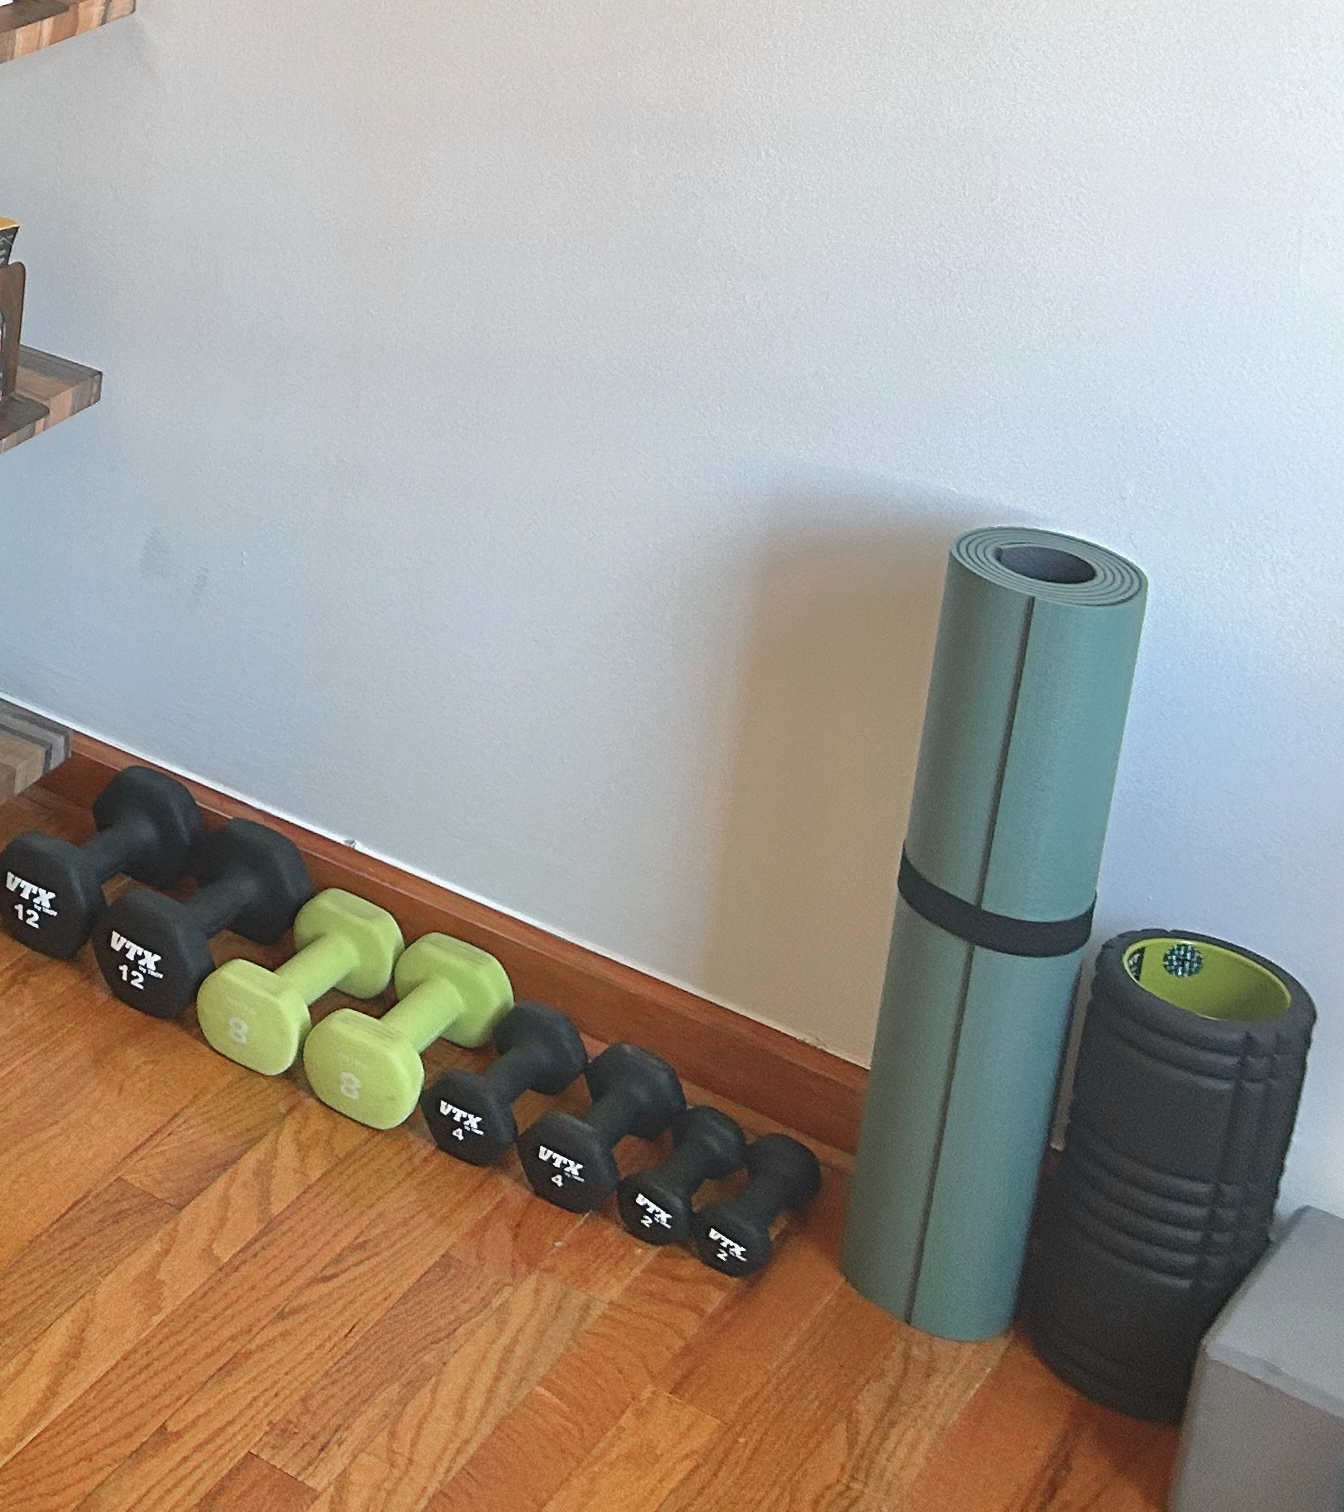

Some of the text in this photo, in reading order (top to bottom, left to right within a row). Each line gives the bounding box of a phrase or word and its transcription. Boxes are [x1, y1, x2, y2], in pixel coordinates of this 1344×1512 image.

[6, 871, 56, 908] VTX
[14, 903, 40, 929] 12
[110, 930, 161, 971] VTX
[119, 964, 144, 990] 12
[228, 1017, 248, 1044] 8
[340, 1072, 360, 1100] 8
[440, 1100, 482, 1129] VTX
[452, 1128, 464, 1140] 4
[538, 1145, 583, 1176] VTX
[551, 1174, 563, 1187] 4
[636, 1193, 672, 1223] VTX
[641, 1215, 652, 1228] 2
[709, 1228, 746, 1257] VTX
[716, 1248, 728, 1261] 2
